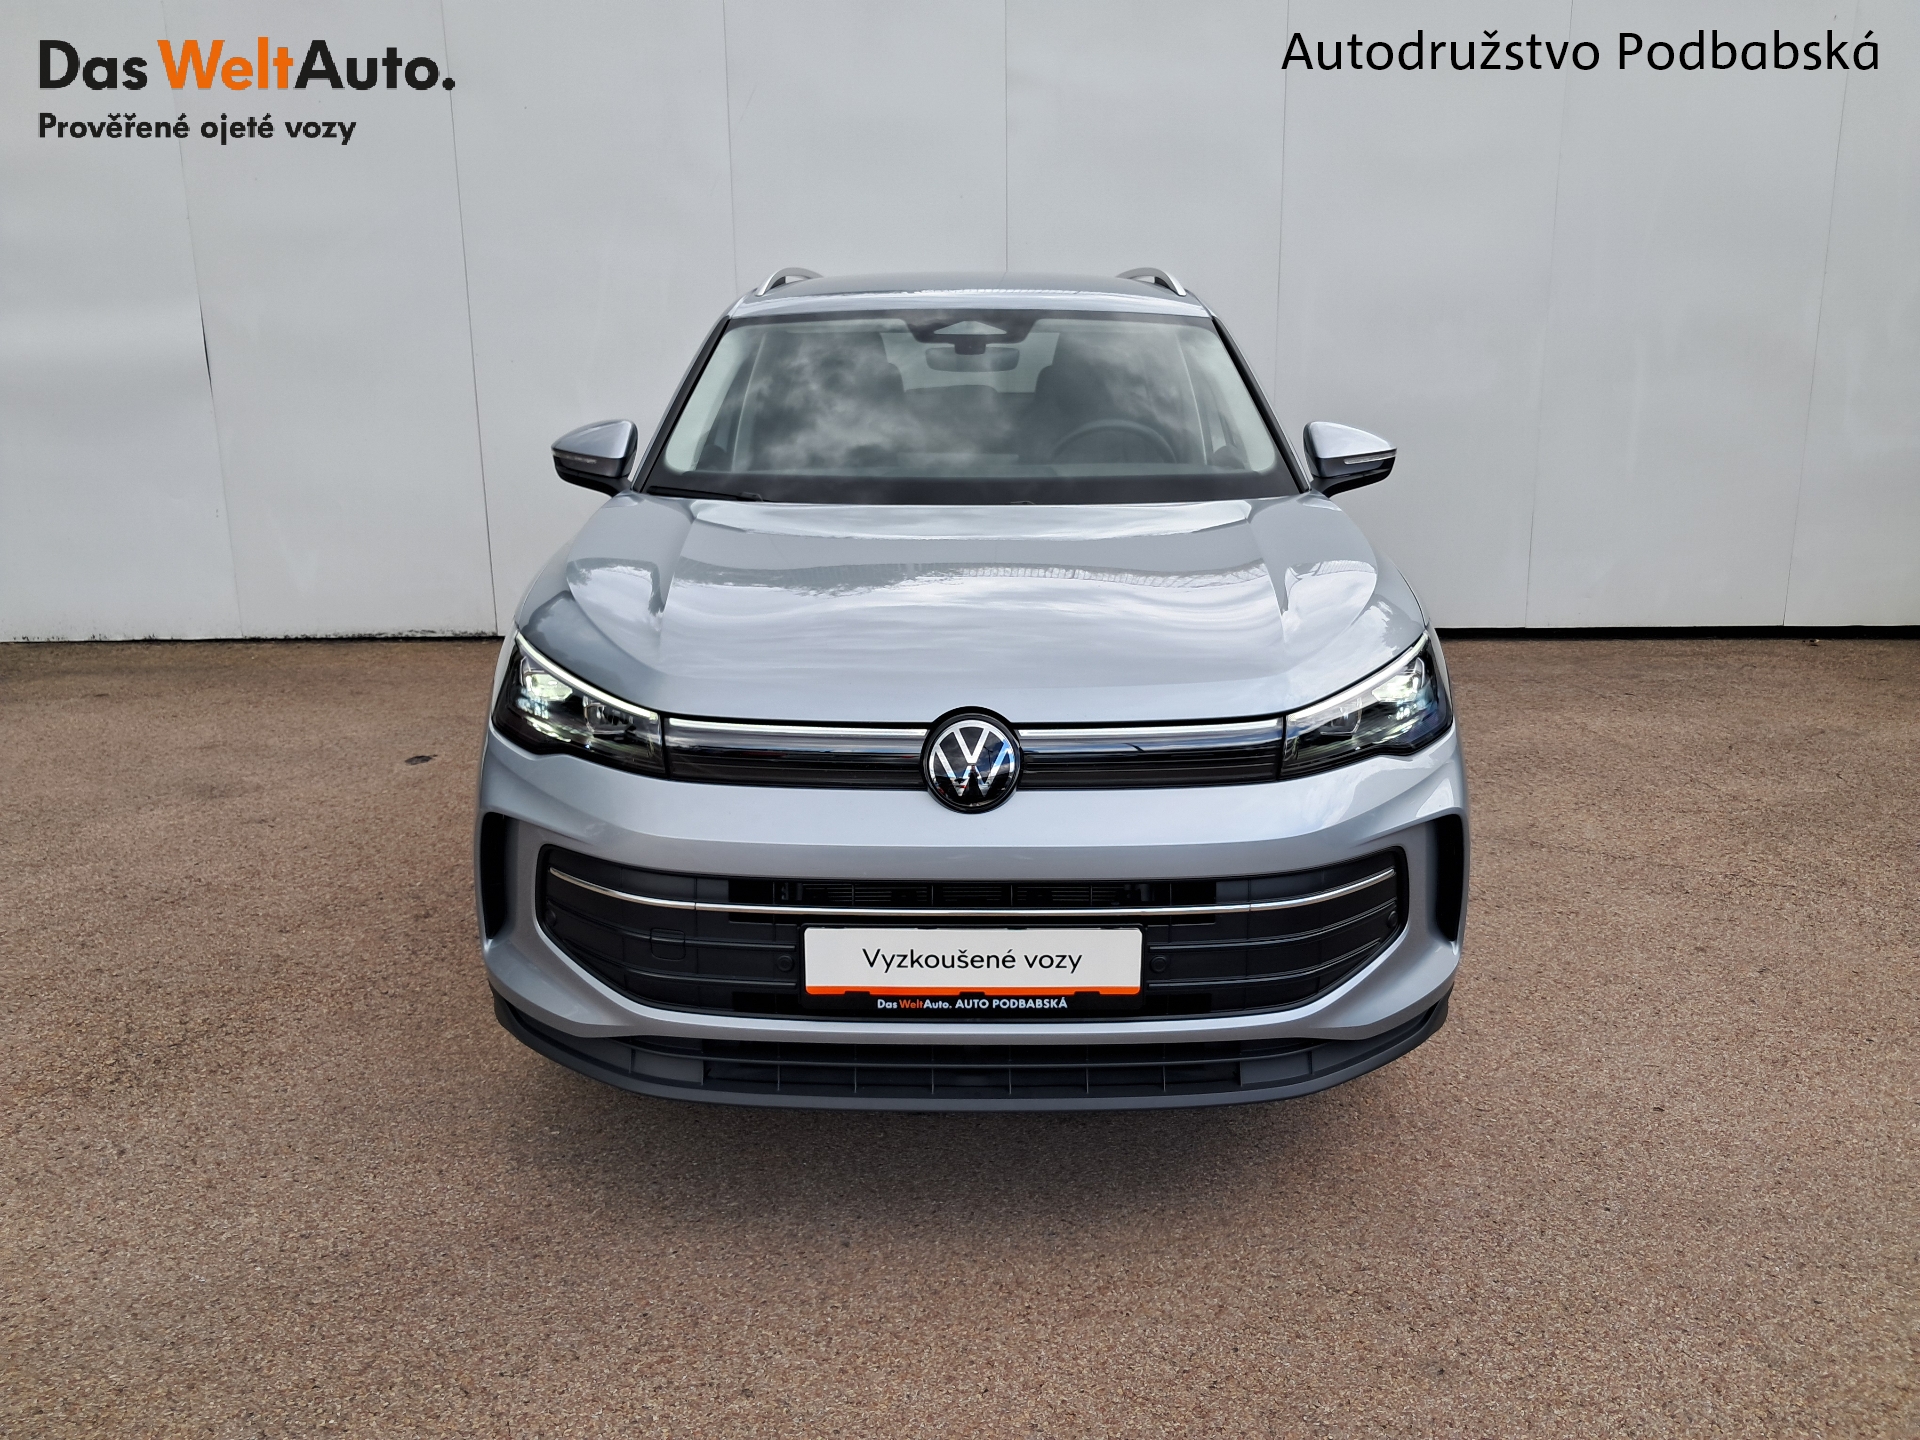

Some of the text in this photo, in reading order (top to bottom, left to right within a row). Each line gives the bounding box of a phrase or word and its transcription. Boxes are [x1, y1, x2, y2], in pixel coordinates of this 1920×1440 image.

[862, 948, 1083, 974] Vyzkoušené vozy
[877, 996, 1068, 1010] Das WeltAuto. AUTO PODBABSKÁ
